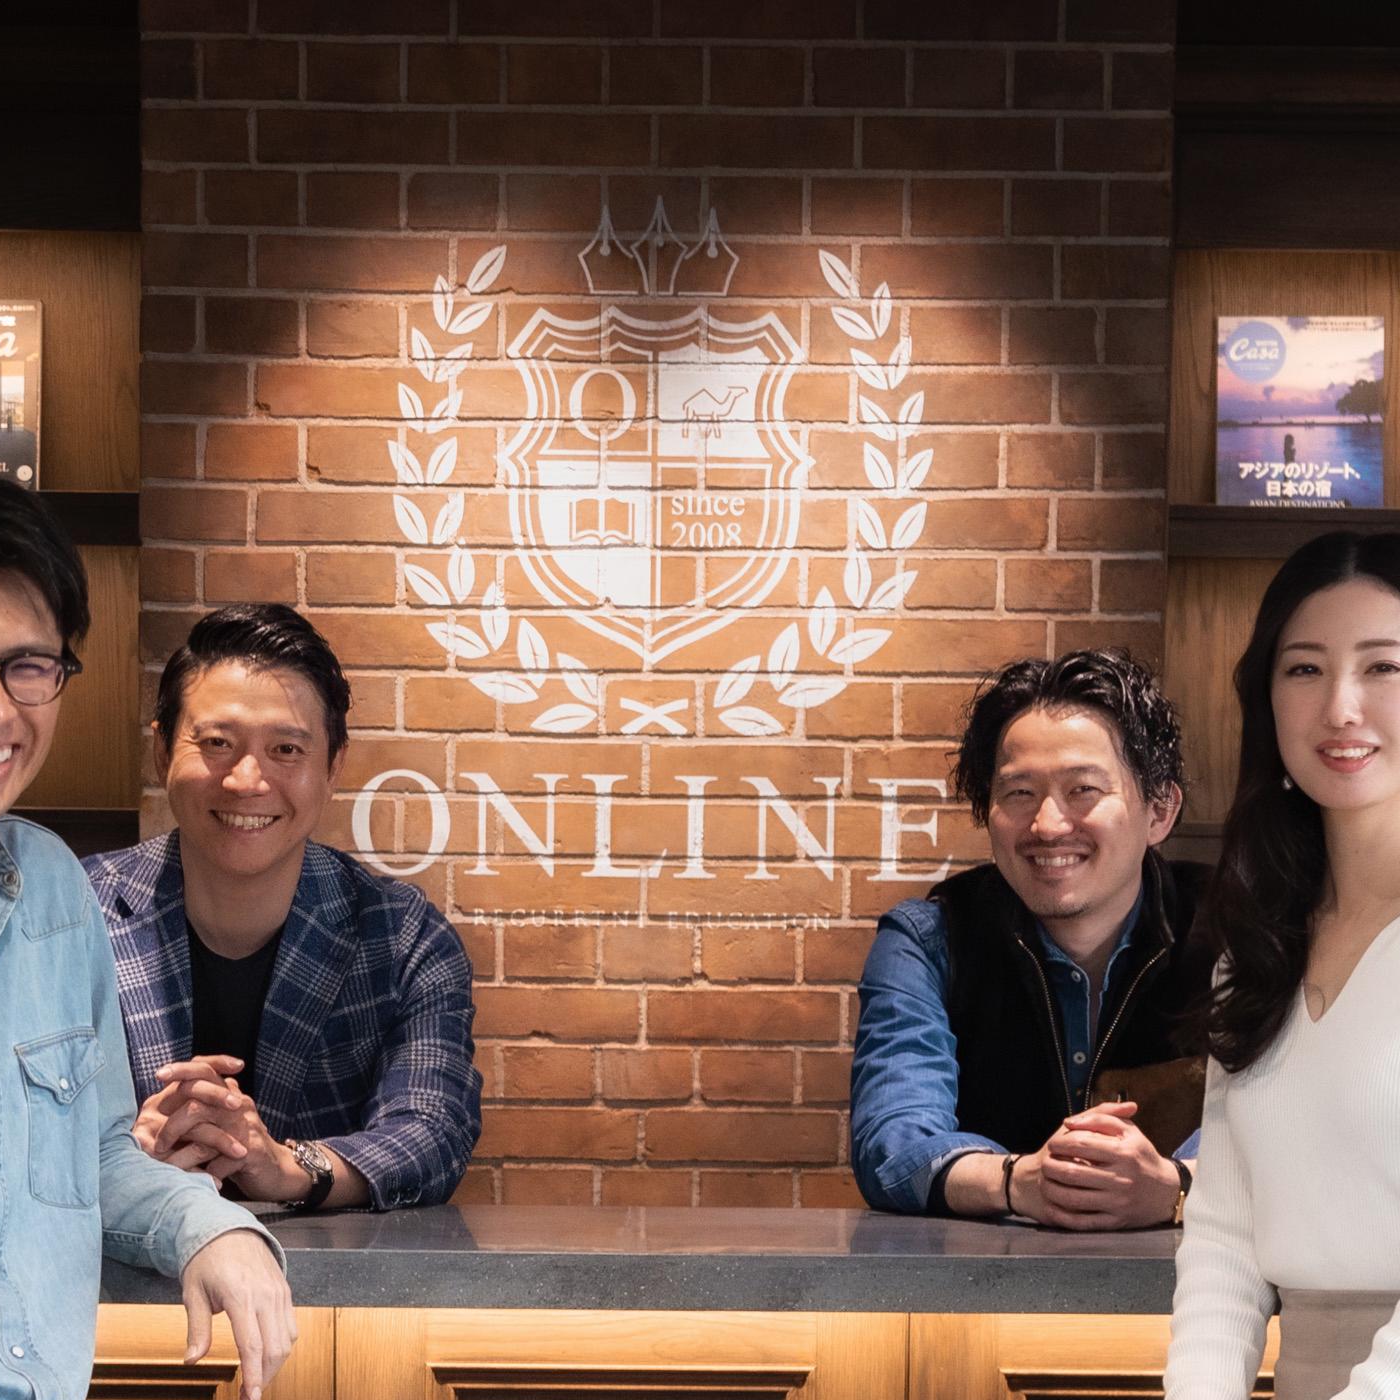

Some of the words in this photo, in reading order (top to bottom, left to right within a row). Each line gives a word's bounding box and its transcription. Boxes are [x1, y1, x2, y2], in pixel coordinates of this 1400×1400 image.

[1229, 338, 1279, 362] Casa
[1238, 462, 1361, 480] アジアのリゾート、
[1266, 480, 1332, 498] 日本の宿
[671, 491, 746, 518] since
[670, 521, 743, 548] 2008
[351, 769, 954, 882] ONLINE
[472, 908, 648, 929] RECURRENT
[667, 911, 831, 931] EDUCATION
